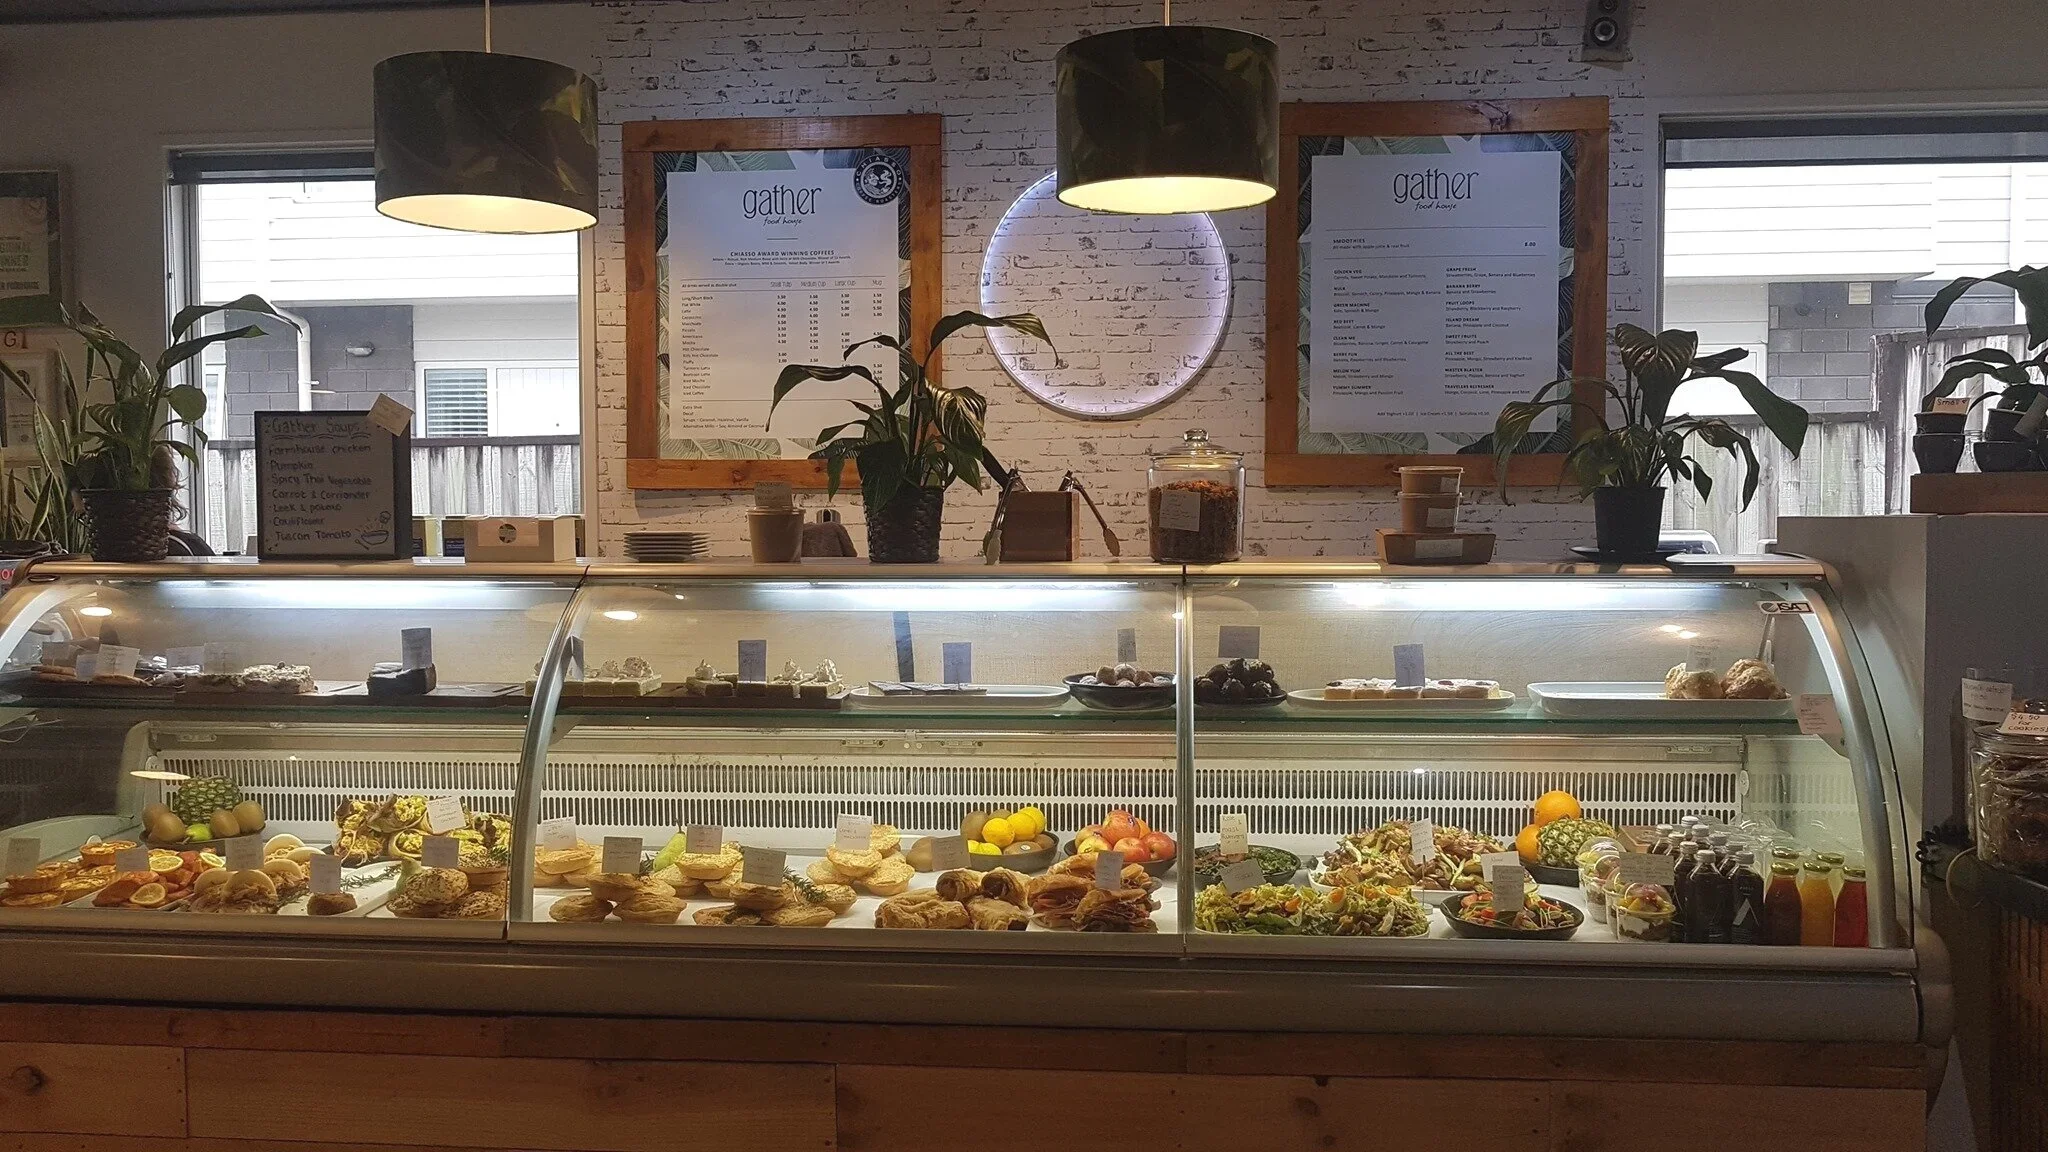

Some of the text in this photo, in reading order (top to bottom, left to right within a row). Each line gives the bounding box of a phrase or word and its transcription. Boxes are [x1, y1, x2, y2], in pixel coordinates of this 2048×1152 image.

[1393, 168, 1479, 204] gather
[743, 184, 822, 219] gather
[1415, 201, 1457, 212] food house
[763, 216, 802, 227] food house
[272, 473, 300, 485] Spicy
[315, 530, 352, 540] Tomato
